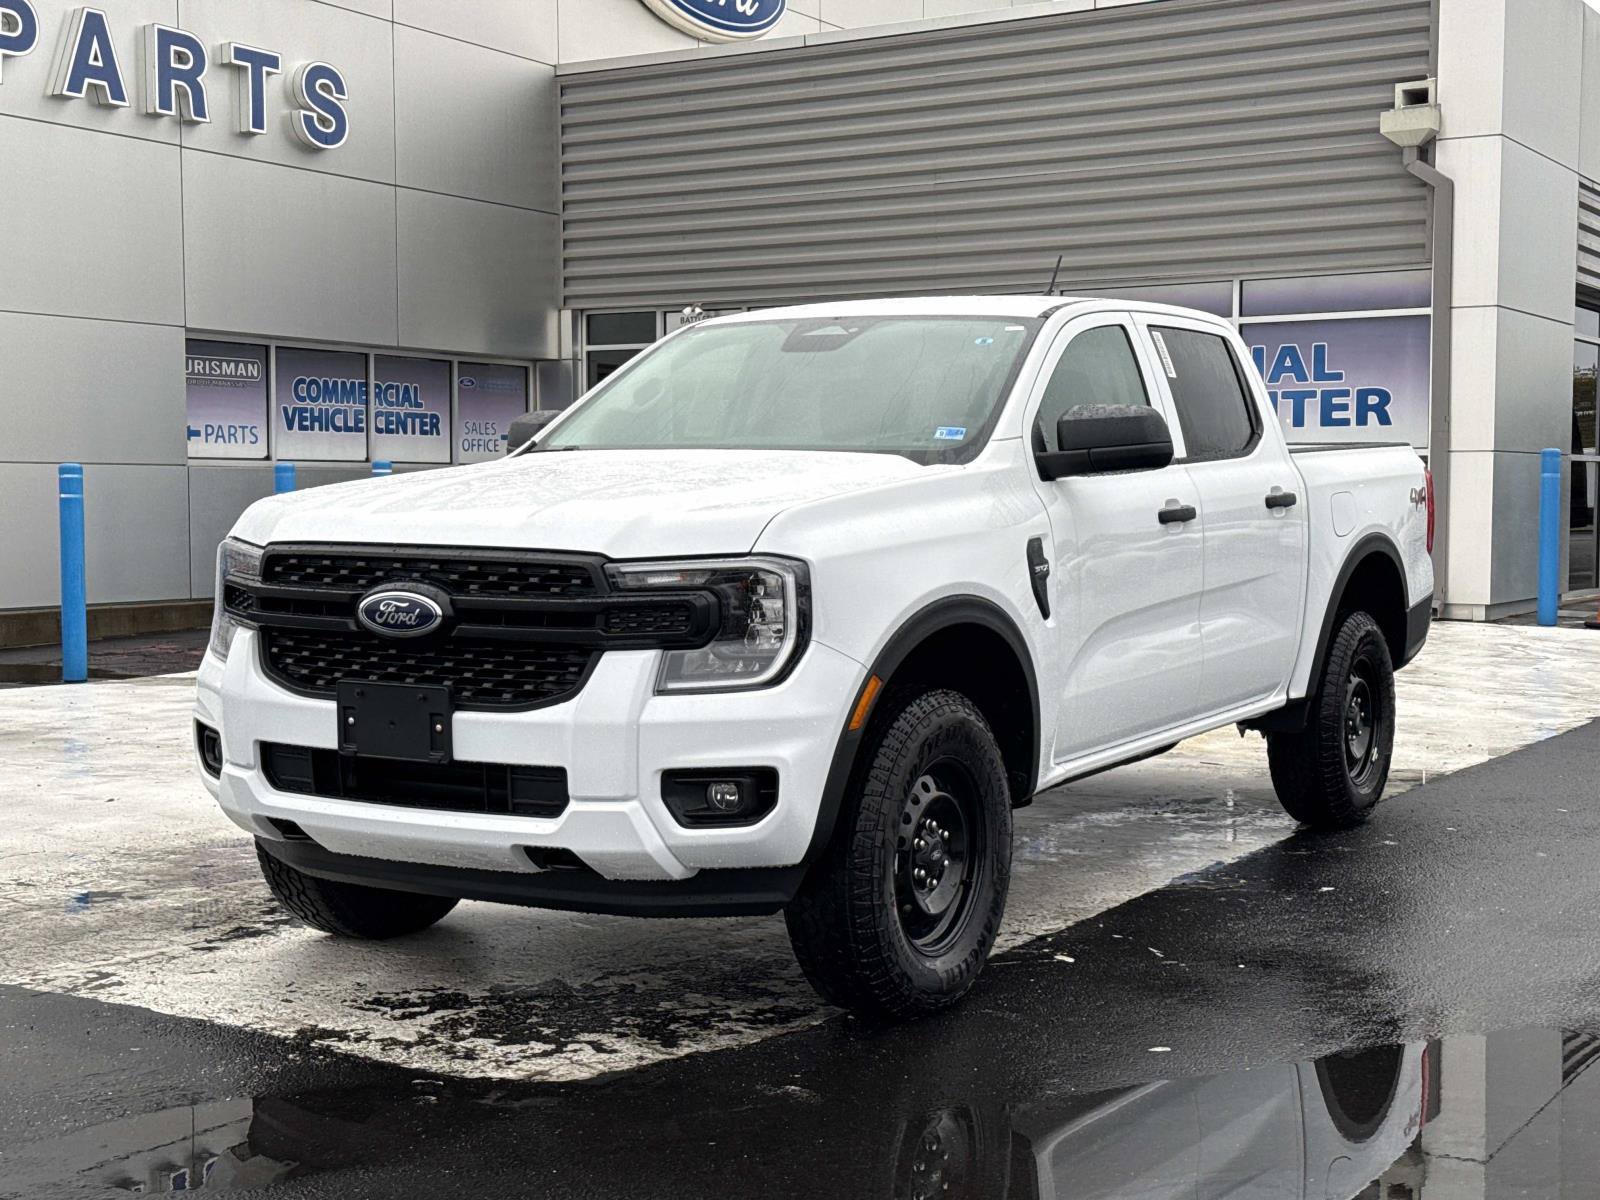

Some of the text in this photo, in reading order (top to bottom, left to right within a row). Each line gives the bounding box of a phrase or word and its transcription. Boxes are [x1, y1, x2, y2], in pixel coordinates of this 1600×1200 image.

[0, 0, 350, 149] PARTS
[292, 376, 425, 410] COMMERCIAL
[282, 405, 441, 437] VEHICLE CENTER
[464, 421, 497, 436] SALES
[204, 424, 259, 444] PARTS
[462, 438, 500, 452] OFFICE
[375, 600, 420, 625] Ford
